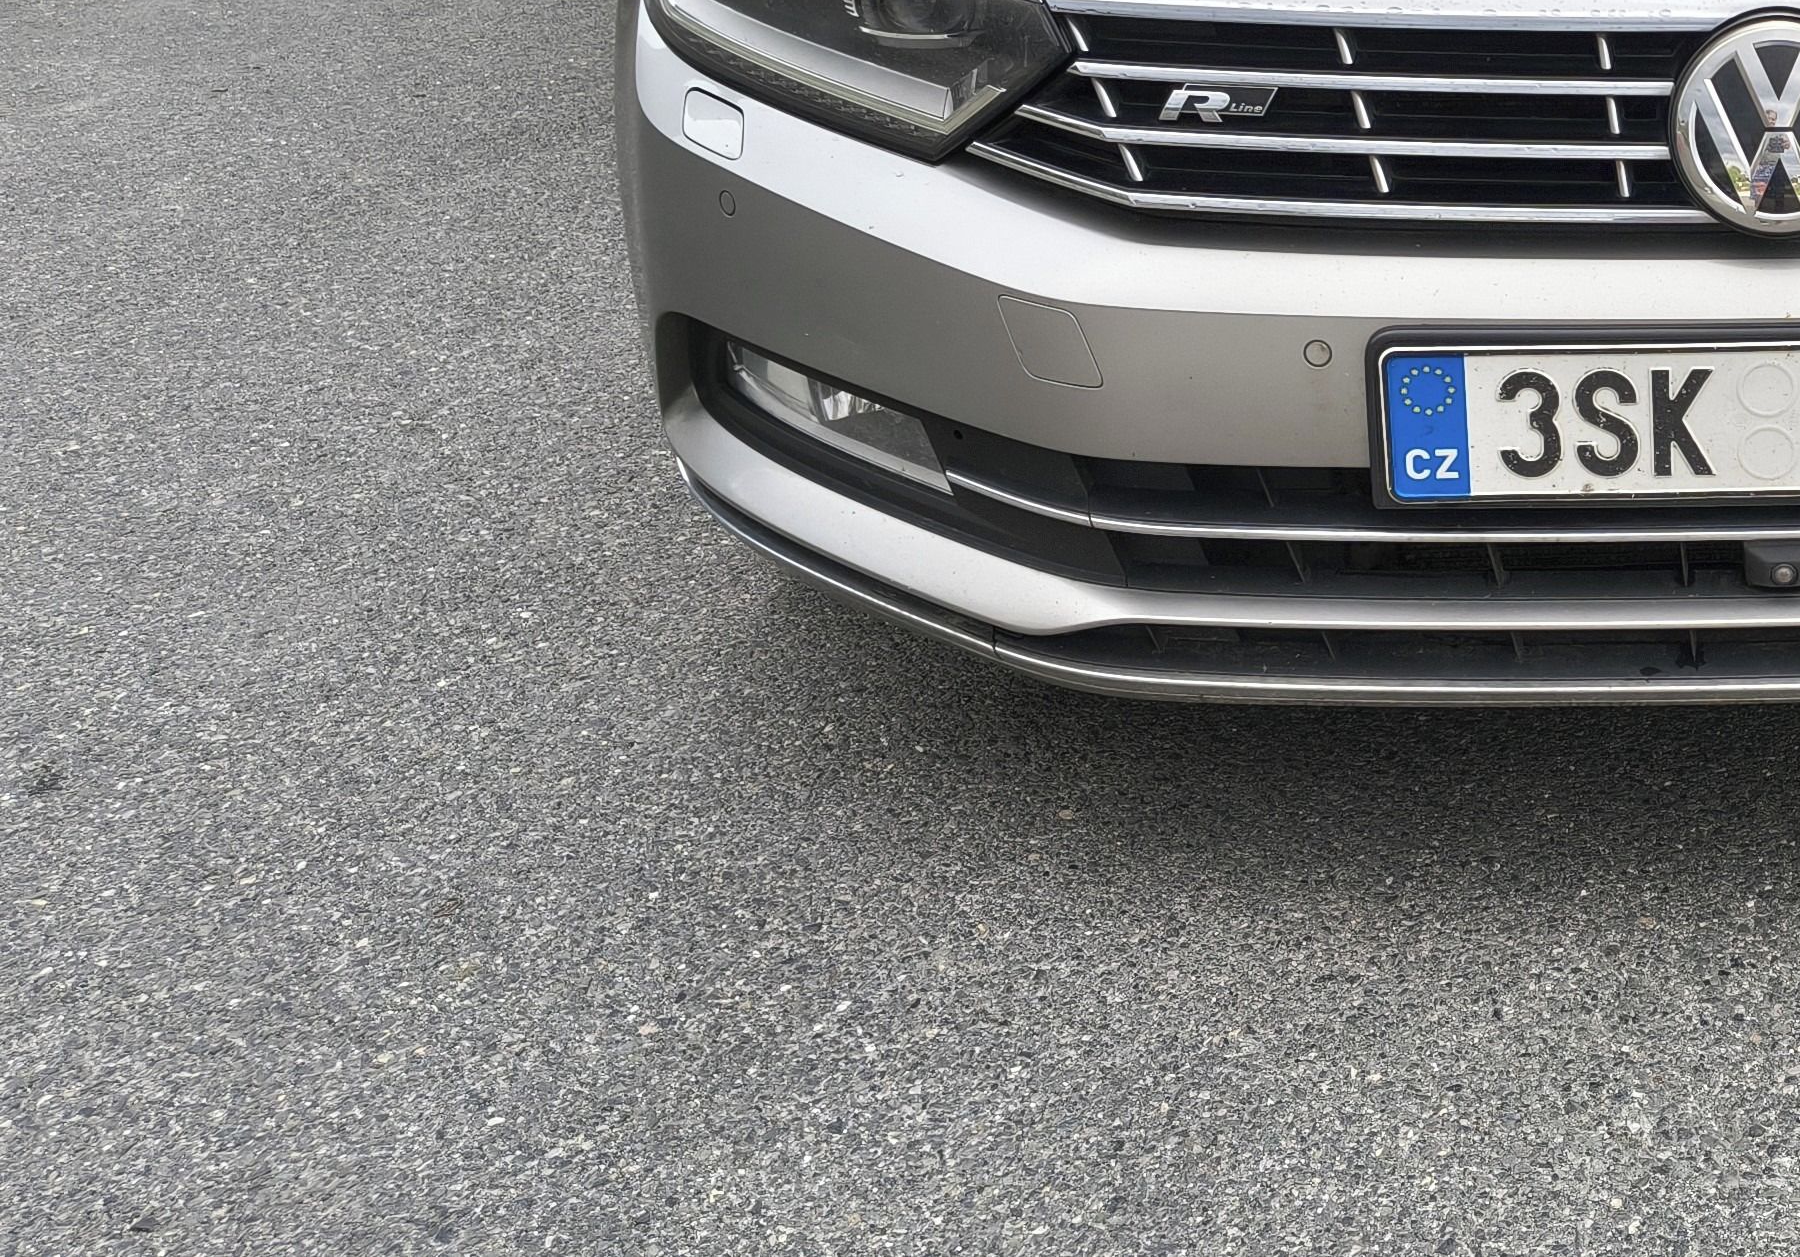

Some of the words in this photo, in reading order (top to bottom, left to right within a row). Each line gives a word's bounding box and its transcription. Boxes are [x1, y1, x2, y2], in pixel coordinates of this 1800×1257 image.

[1159, 90, 1230, 122] R
[1229, 103, 1263, 113] Line
[1497, 368, 1715, 478] 3SK
[1405, 448, 1460, 480] CZ
